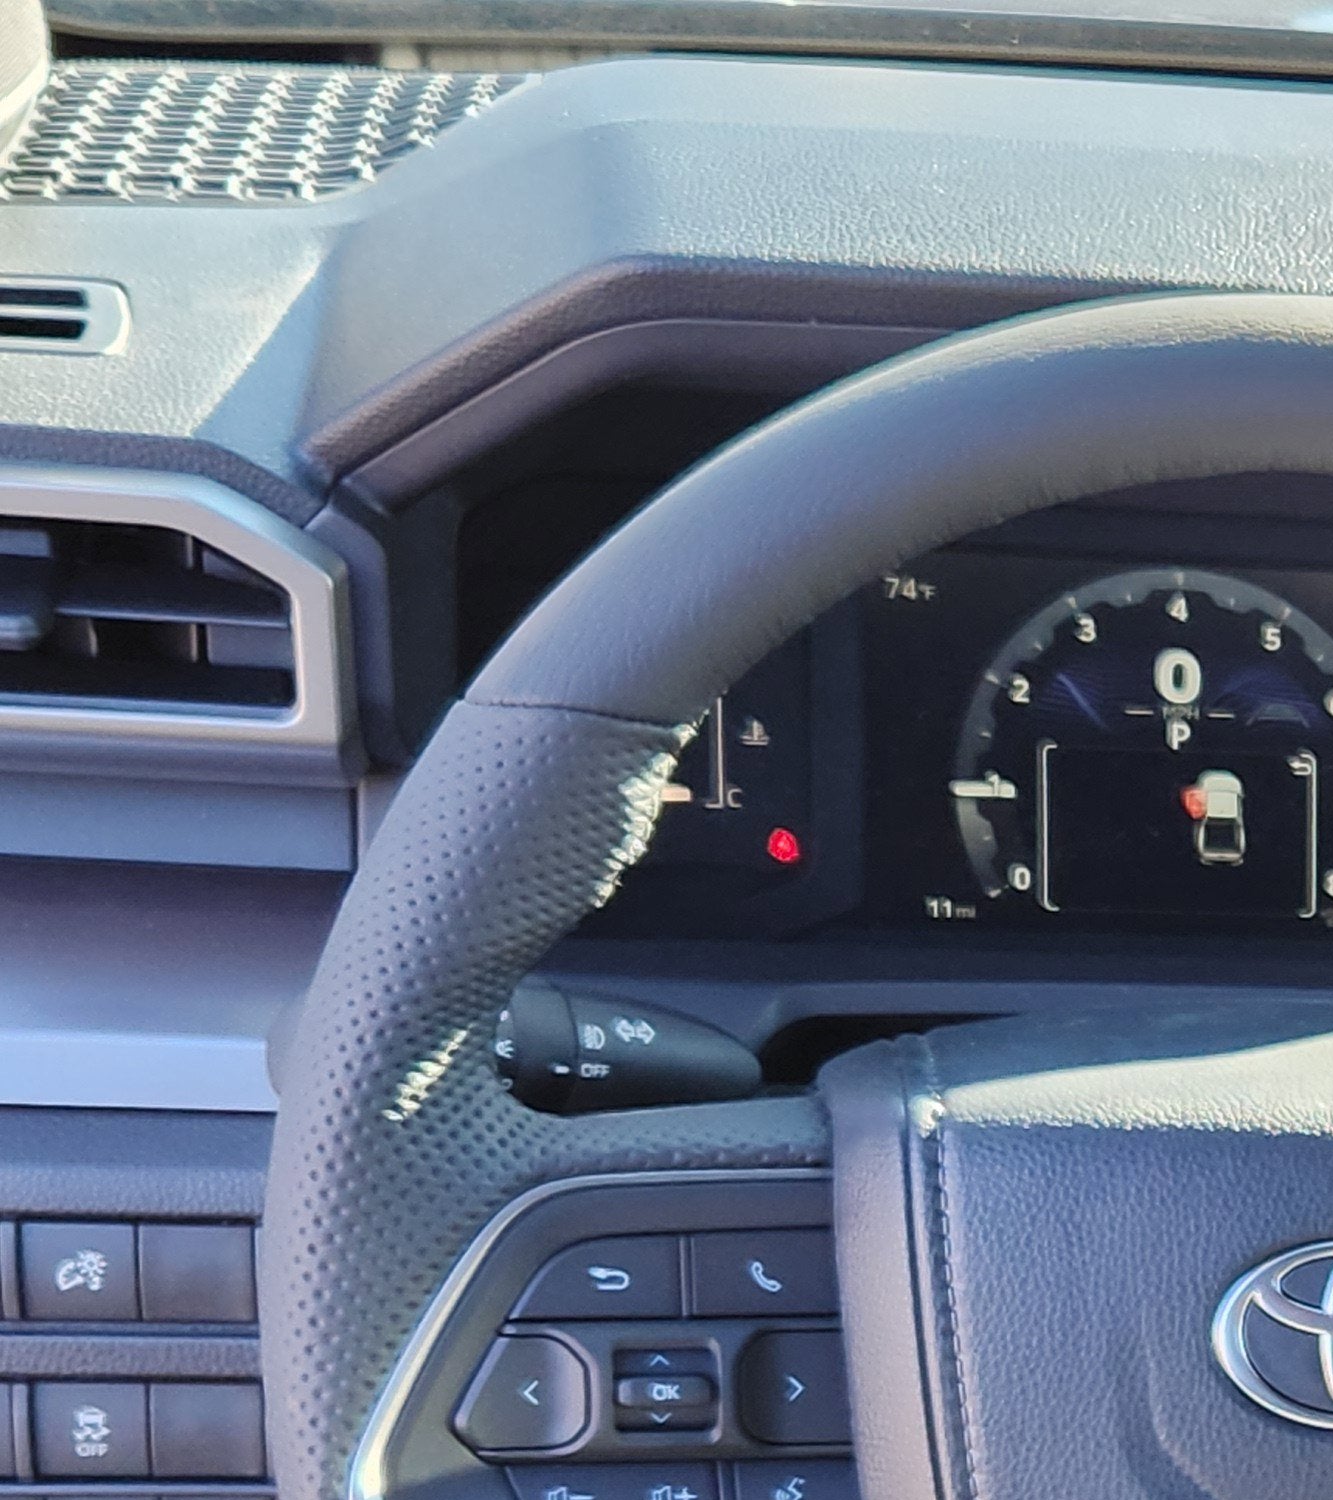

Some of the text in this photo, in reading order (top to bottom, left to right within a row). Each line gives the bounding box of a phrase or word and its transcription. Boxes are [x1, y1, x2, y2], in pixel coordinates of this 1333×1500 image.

[1166, 594, 1189, 622] 4
[1077, 614, 1097, 643] 3
[1261, 623, 1282, 651] 5
[1011, 675, 1031, 703] 2
[1153, 647, 1202, 704] 0
[1167, 719, 1191, 750] P
[580, 1063, 610, 1079] OFF
[652, 1384, 681, 1401] OK
